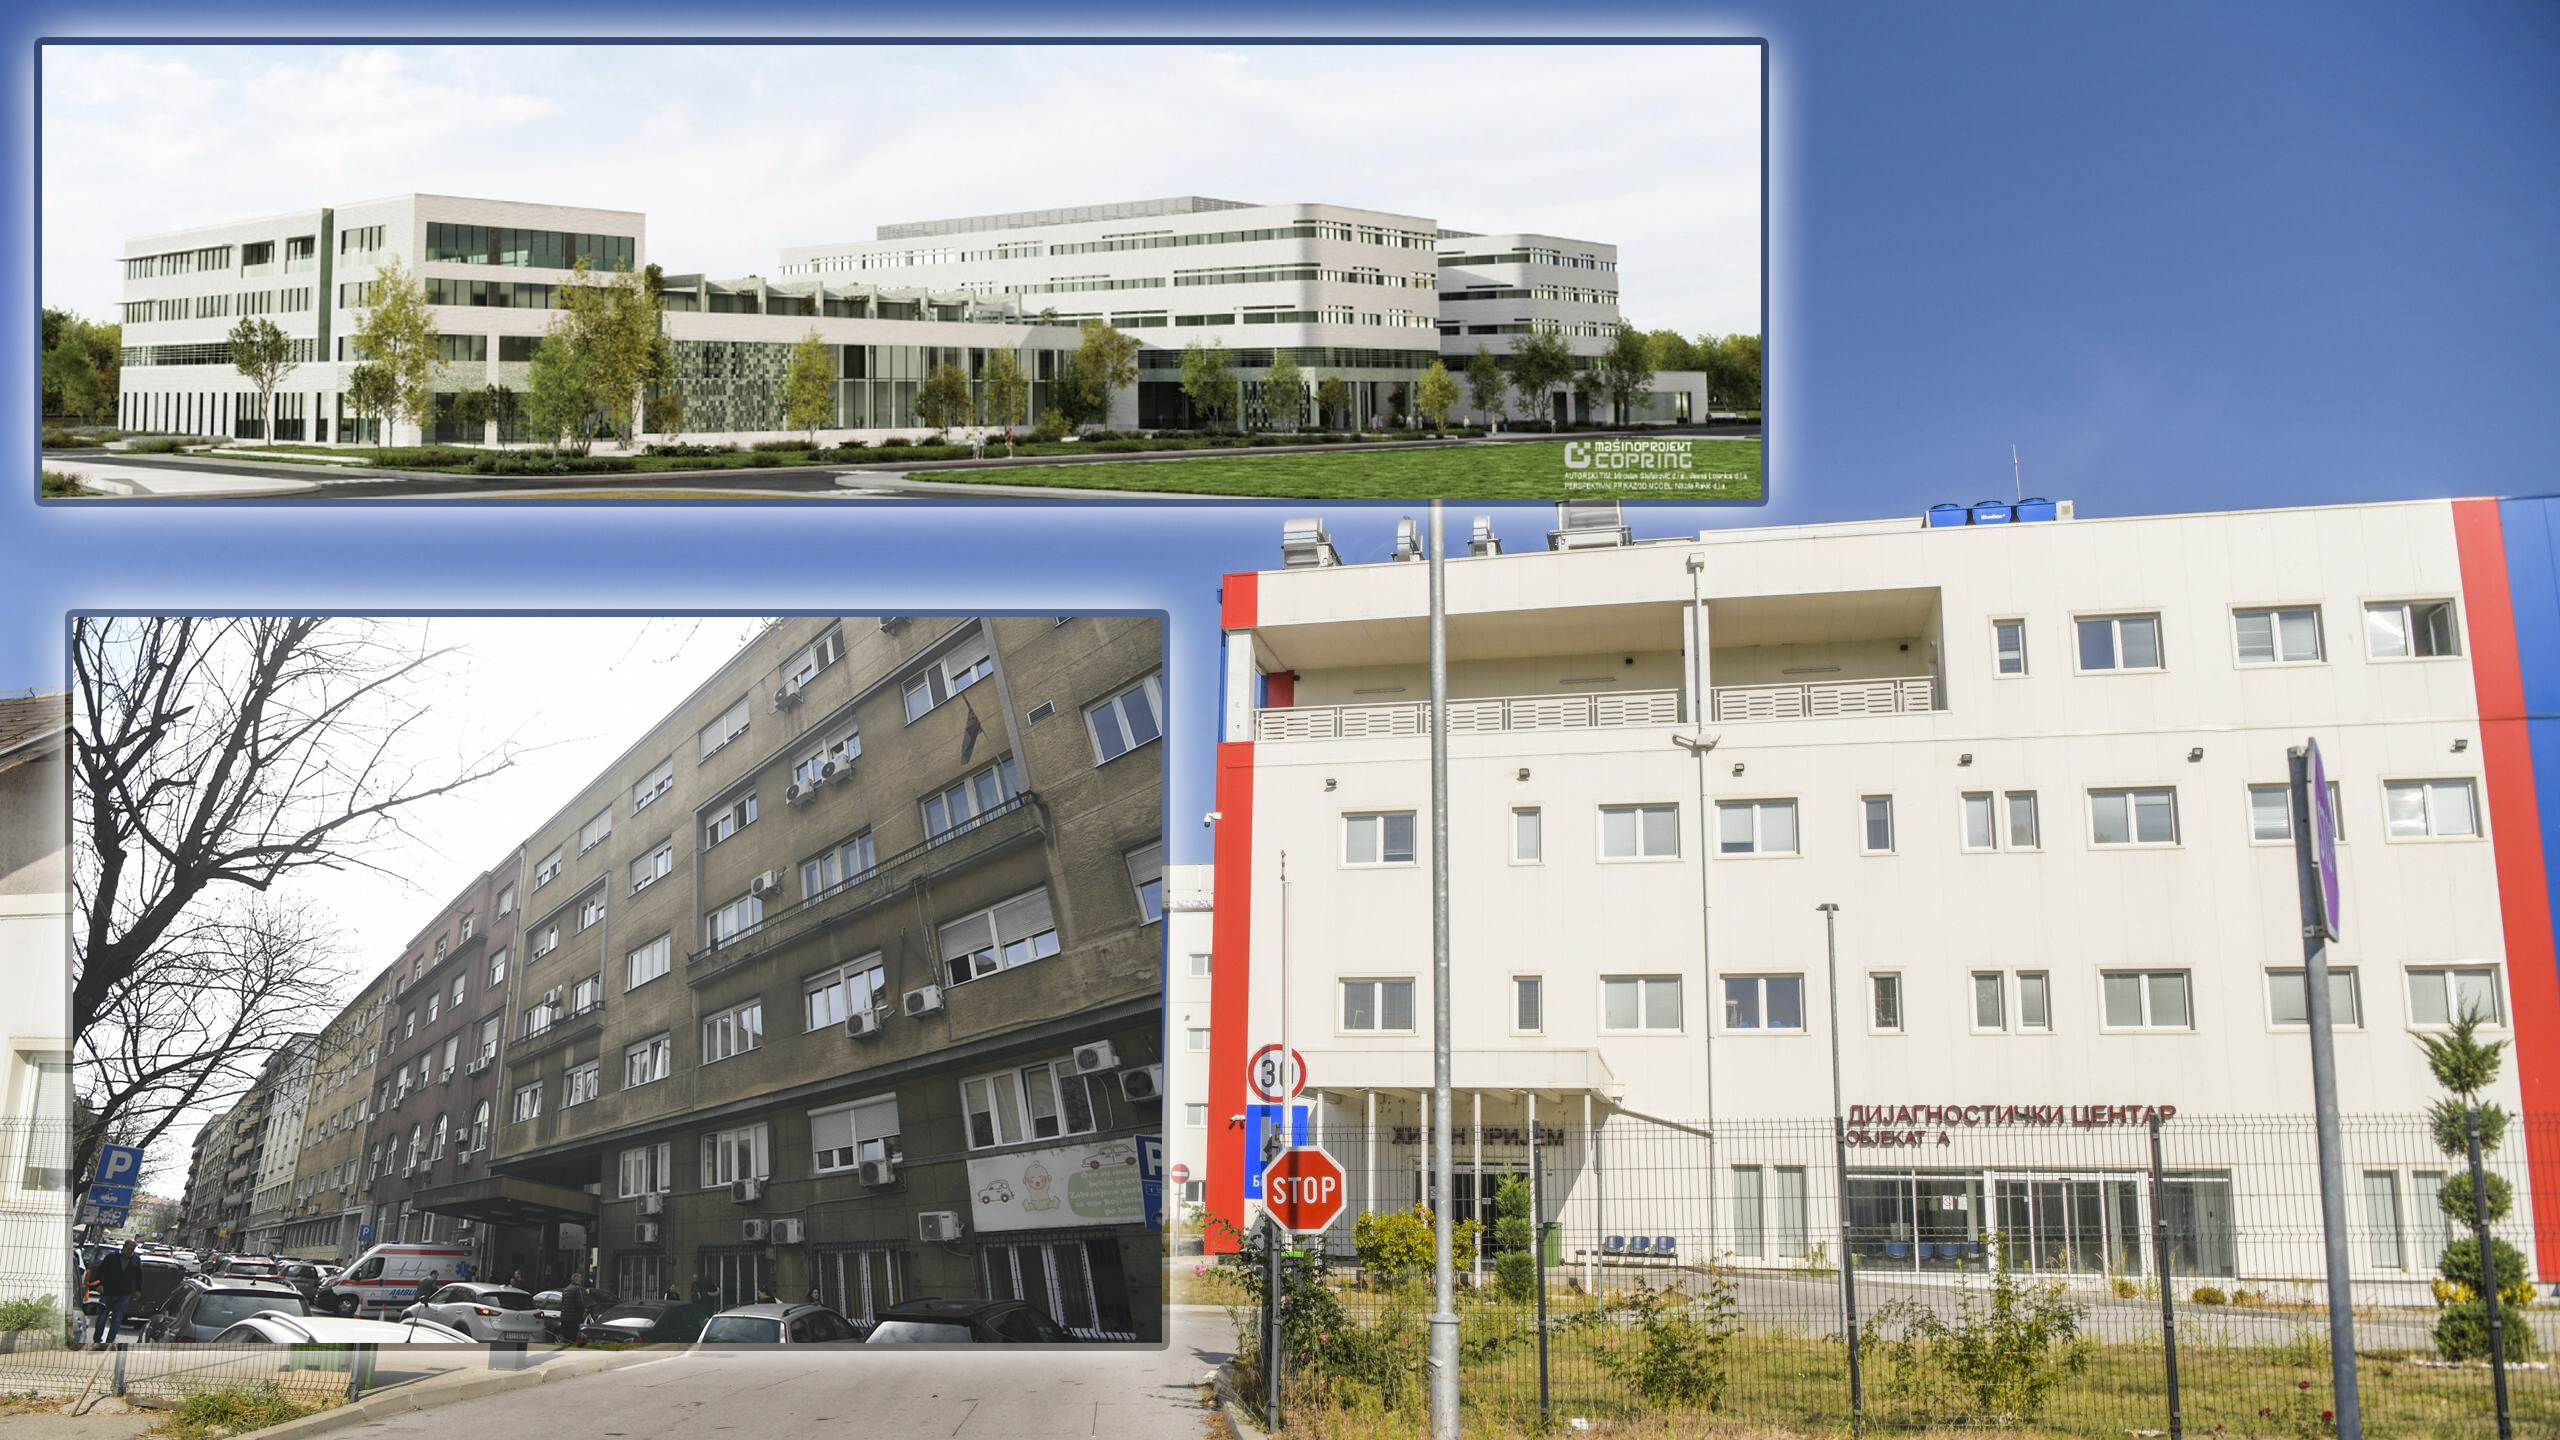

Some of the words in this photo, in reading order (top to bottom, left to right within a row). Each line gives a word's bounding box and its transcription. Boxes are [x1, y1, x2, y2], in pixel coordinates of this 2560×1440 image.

[1848, 1104, 2065, 1127] ДИЈАГНОСТИЧКИ
[2072, 1104, 2177, 1127] ЦЕНТАР
[1845, 1130, 1927, 1146] ОБЈЕКАТ
[105, 1150, 133, 1180] P
[1081, 1171, 1098, 1179] Ovo
[1070, 1189, 1120, 1199] Zabranjeno
[1272, 1176, 1336, 1205] STOP
[1105, 1208, 1116, 1216] po
